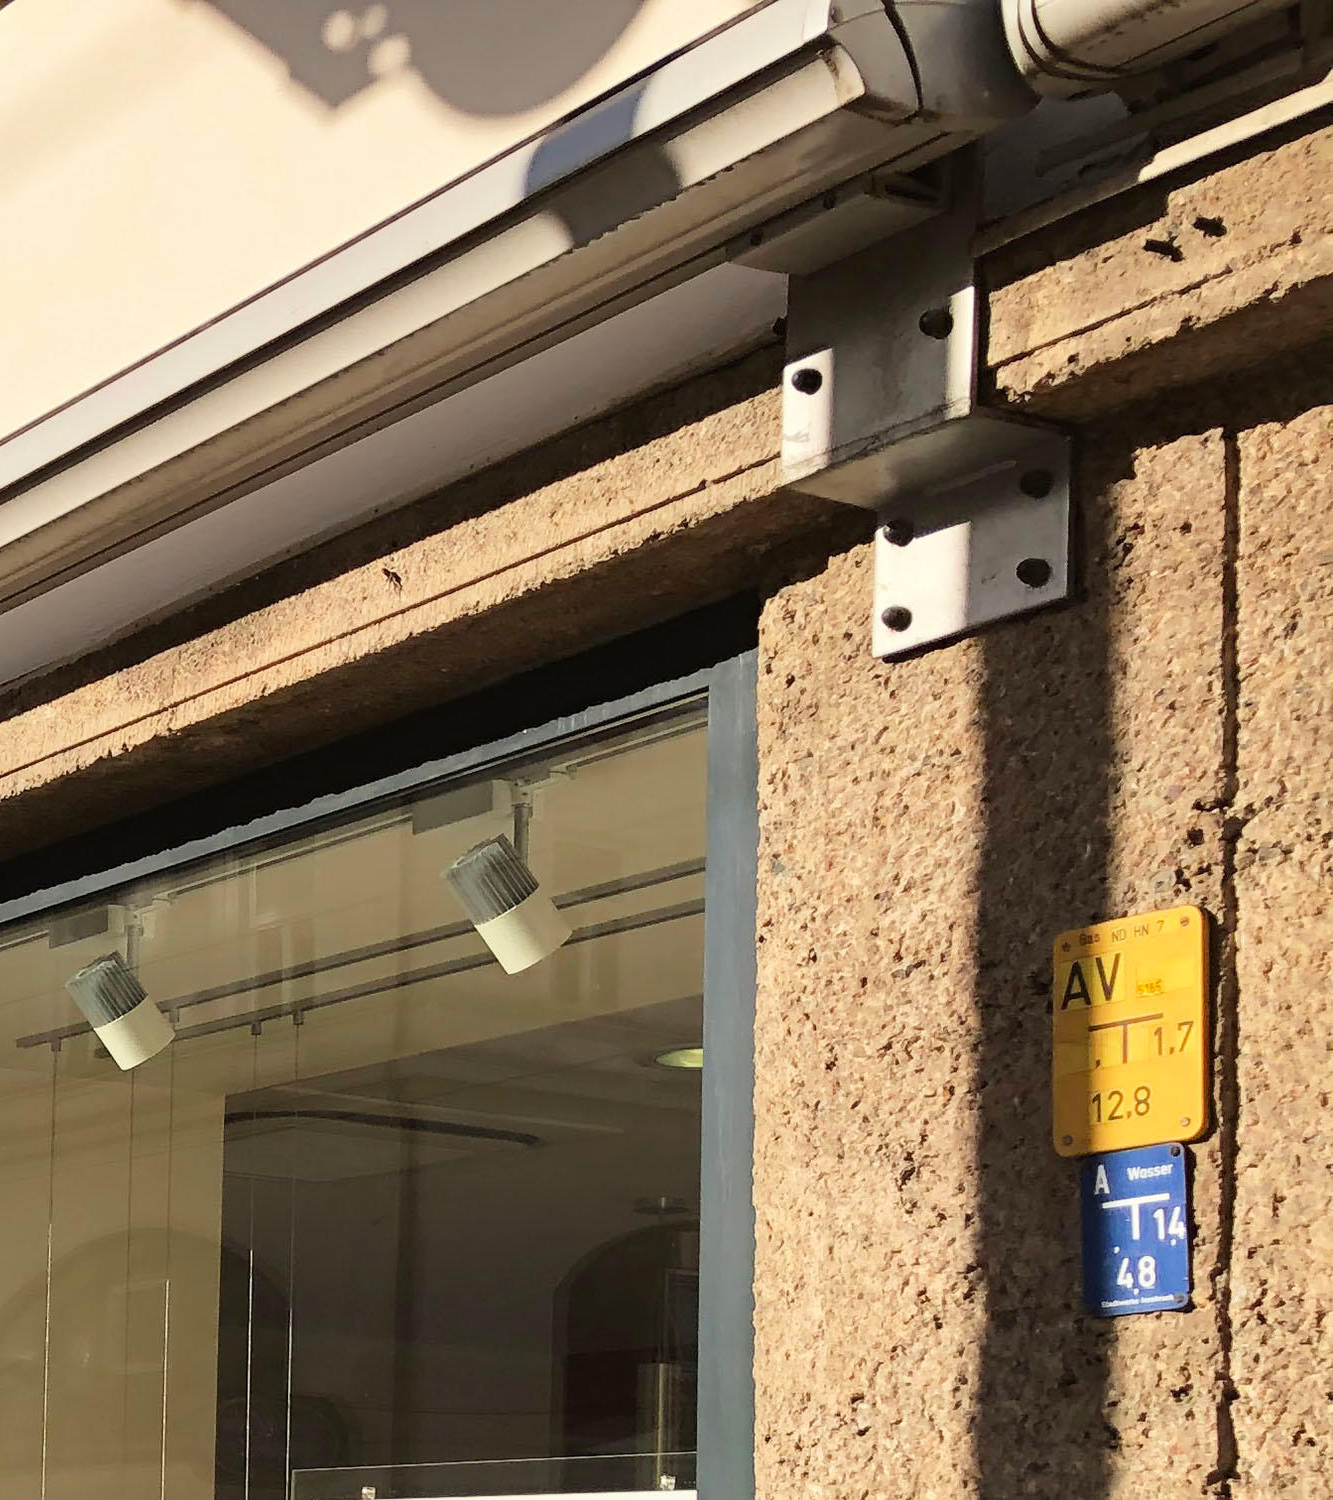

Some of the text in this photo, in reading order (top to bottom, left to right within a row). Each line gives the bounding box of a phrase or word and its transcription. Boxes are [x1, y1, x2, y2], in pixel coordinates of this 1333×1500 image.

[1060, 953, 1121, 1010] AV
[1091, 1085, 1151, 1122] 12,8
[1094, 1163, 1173, 1195] A Wasser
